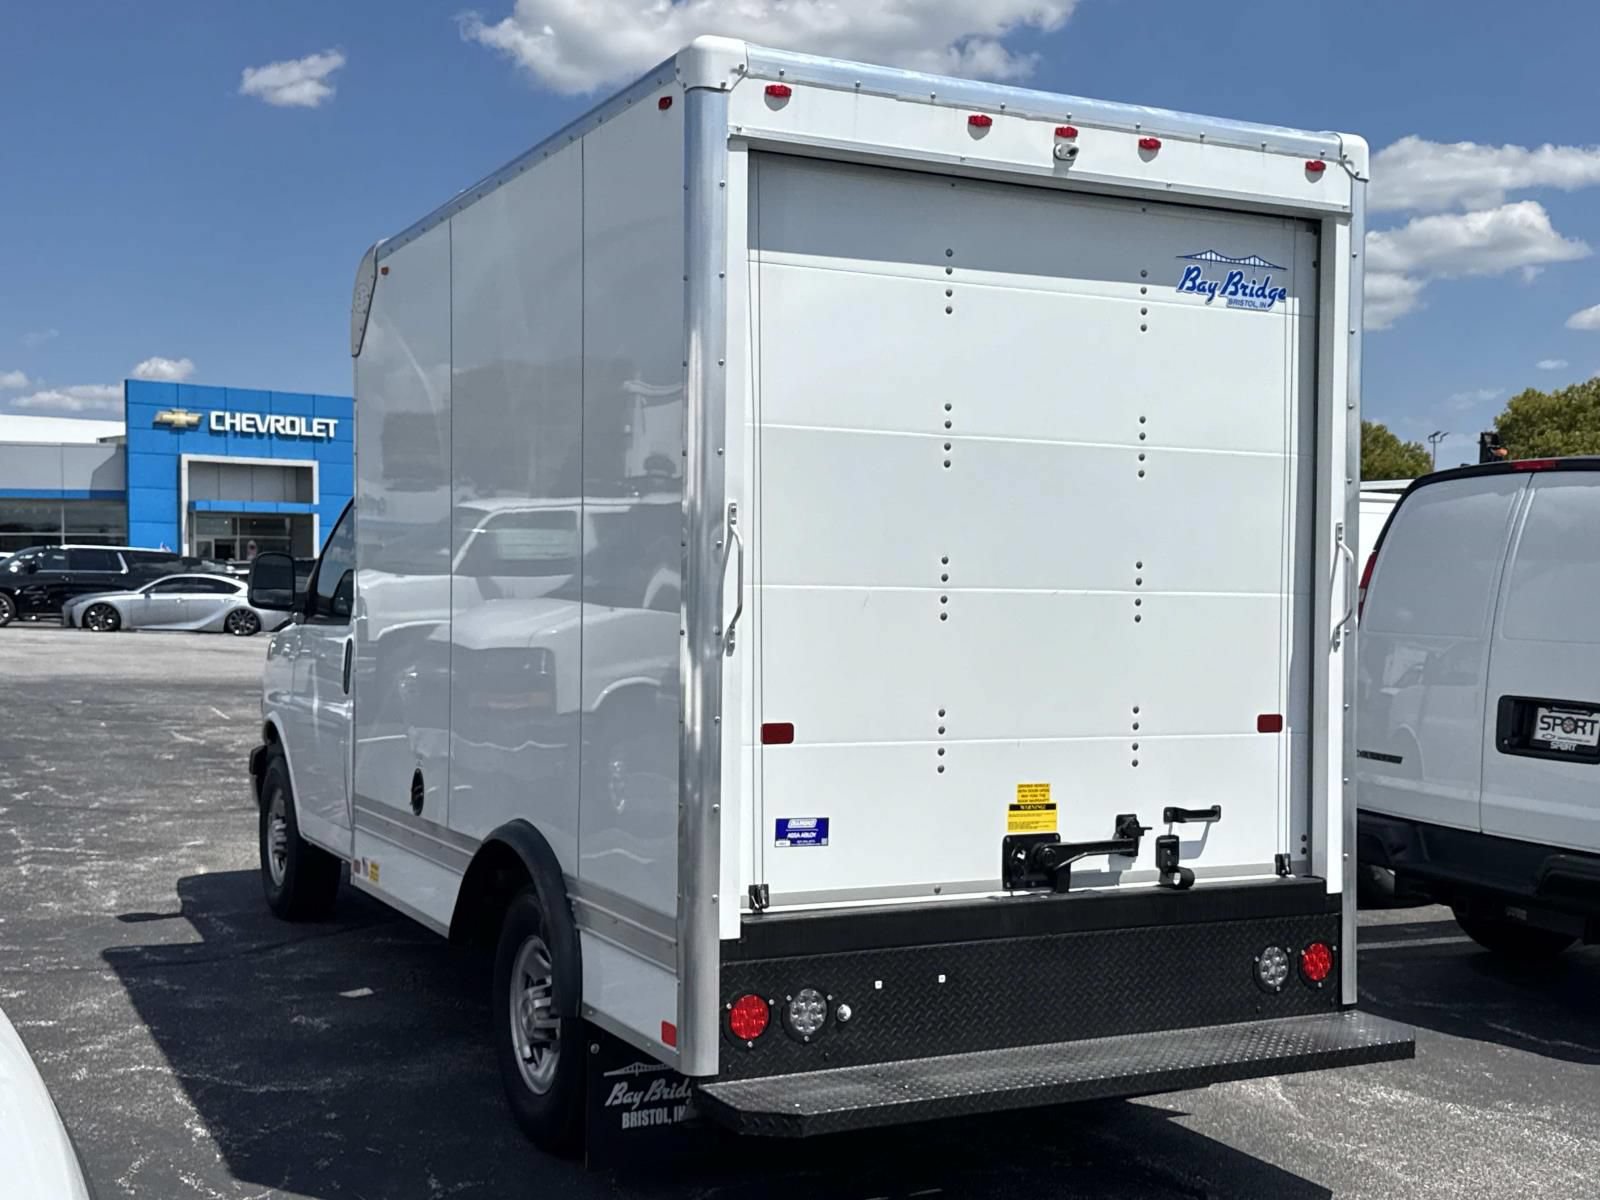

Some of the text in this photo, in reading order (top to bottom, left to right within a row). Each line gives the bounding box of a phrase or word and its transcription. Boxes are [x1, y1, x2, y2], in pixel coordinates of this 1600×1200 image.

[1177, 265, 1287, 308] Bay Bridge
[209, 410, 339, 438] CHEVROLET
[1539, 714, 1599, 736] SPORT
[604, 1081, 644, 1110] Bay
[622, 1107, 672, 1129] BRISTOL,
